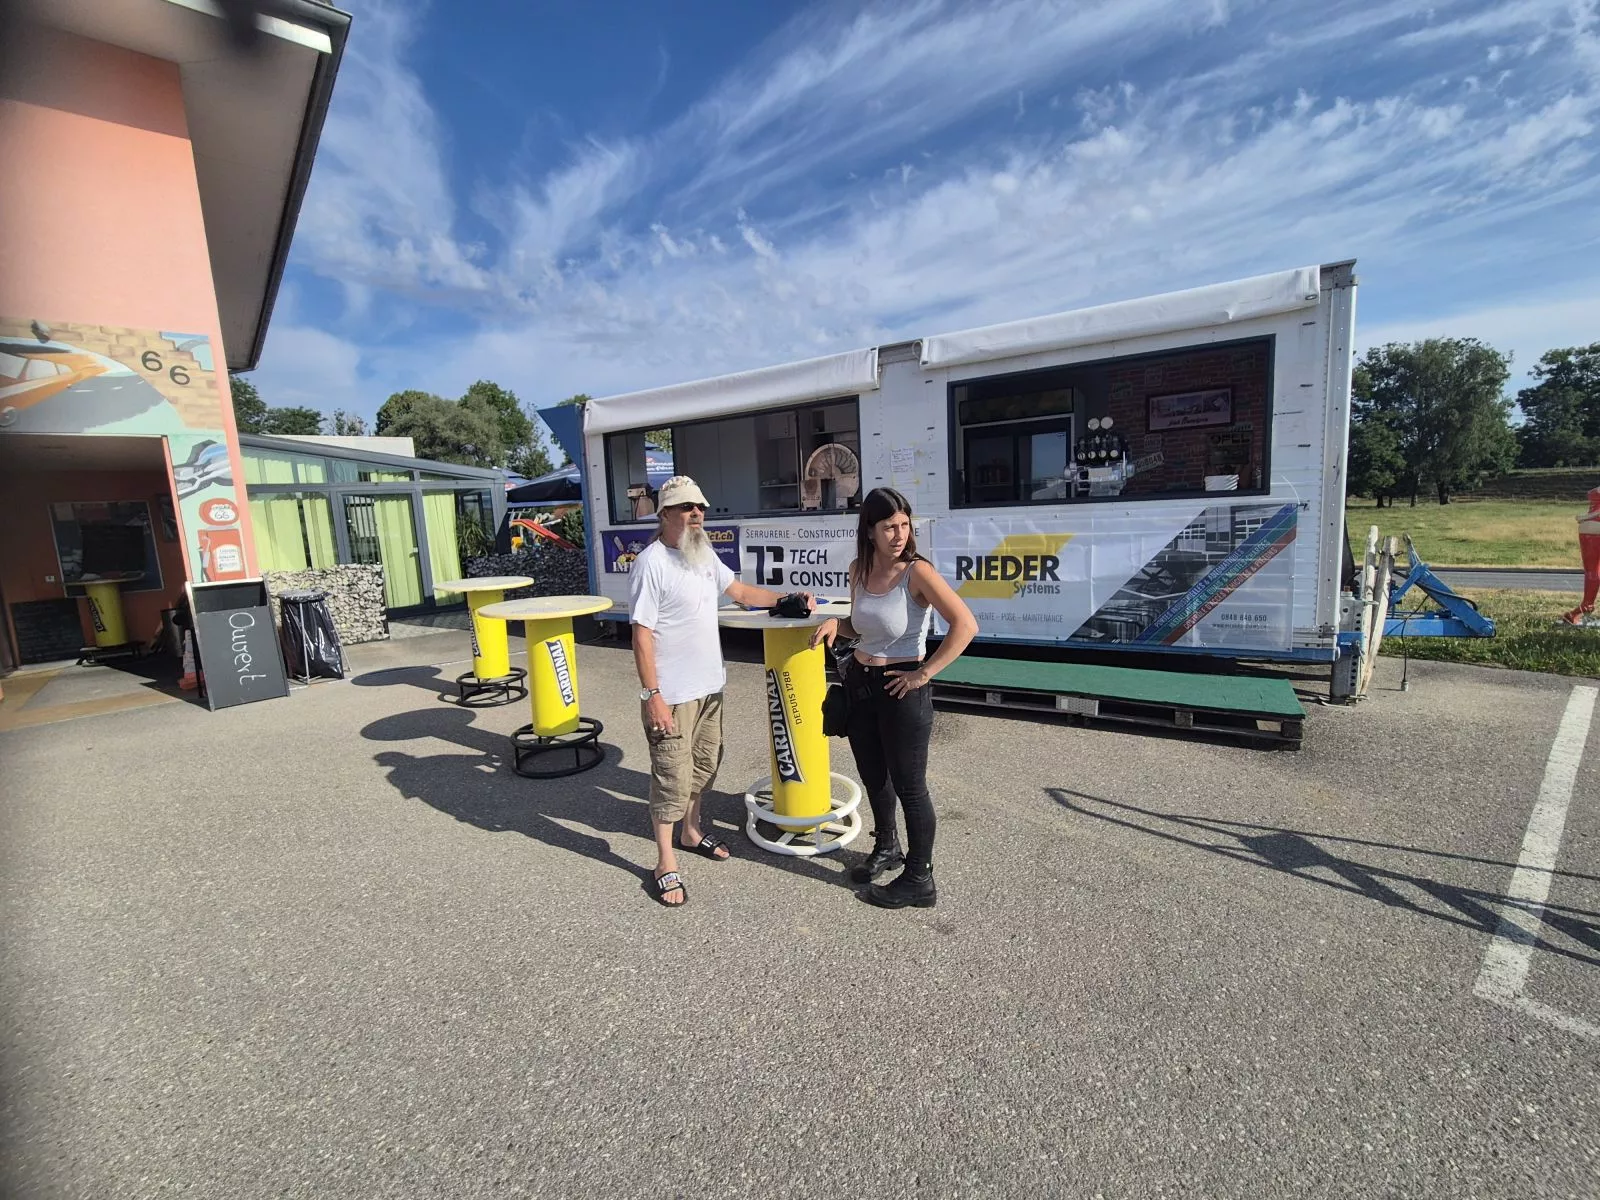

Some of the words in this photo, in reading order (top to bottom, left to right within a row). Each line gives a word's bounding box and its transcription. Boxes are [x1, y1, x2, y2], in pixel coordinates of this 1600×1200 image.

[746, 528, 790, 538] SERRURERIE
[797, 528, 859, 538] CONSTRUCTIO
[789, 549, 828, 565] TECH
[955, 555, 1061, 582] RIEDER
[789, 571, 850, 588] CONSTR
[1013, 581, 1061, 597] Systems
[1022, 613, 1064, 622] MAINTENANCE
[229, 612, 267, 685] Ouvert
[549, 640, 575, 704] CARDINAL
[783, 671, 794, 691] 1788
[789, 693, 802, 725] DEPUIS
[767, 671, 796, 776] CARDINAL
